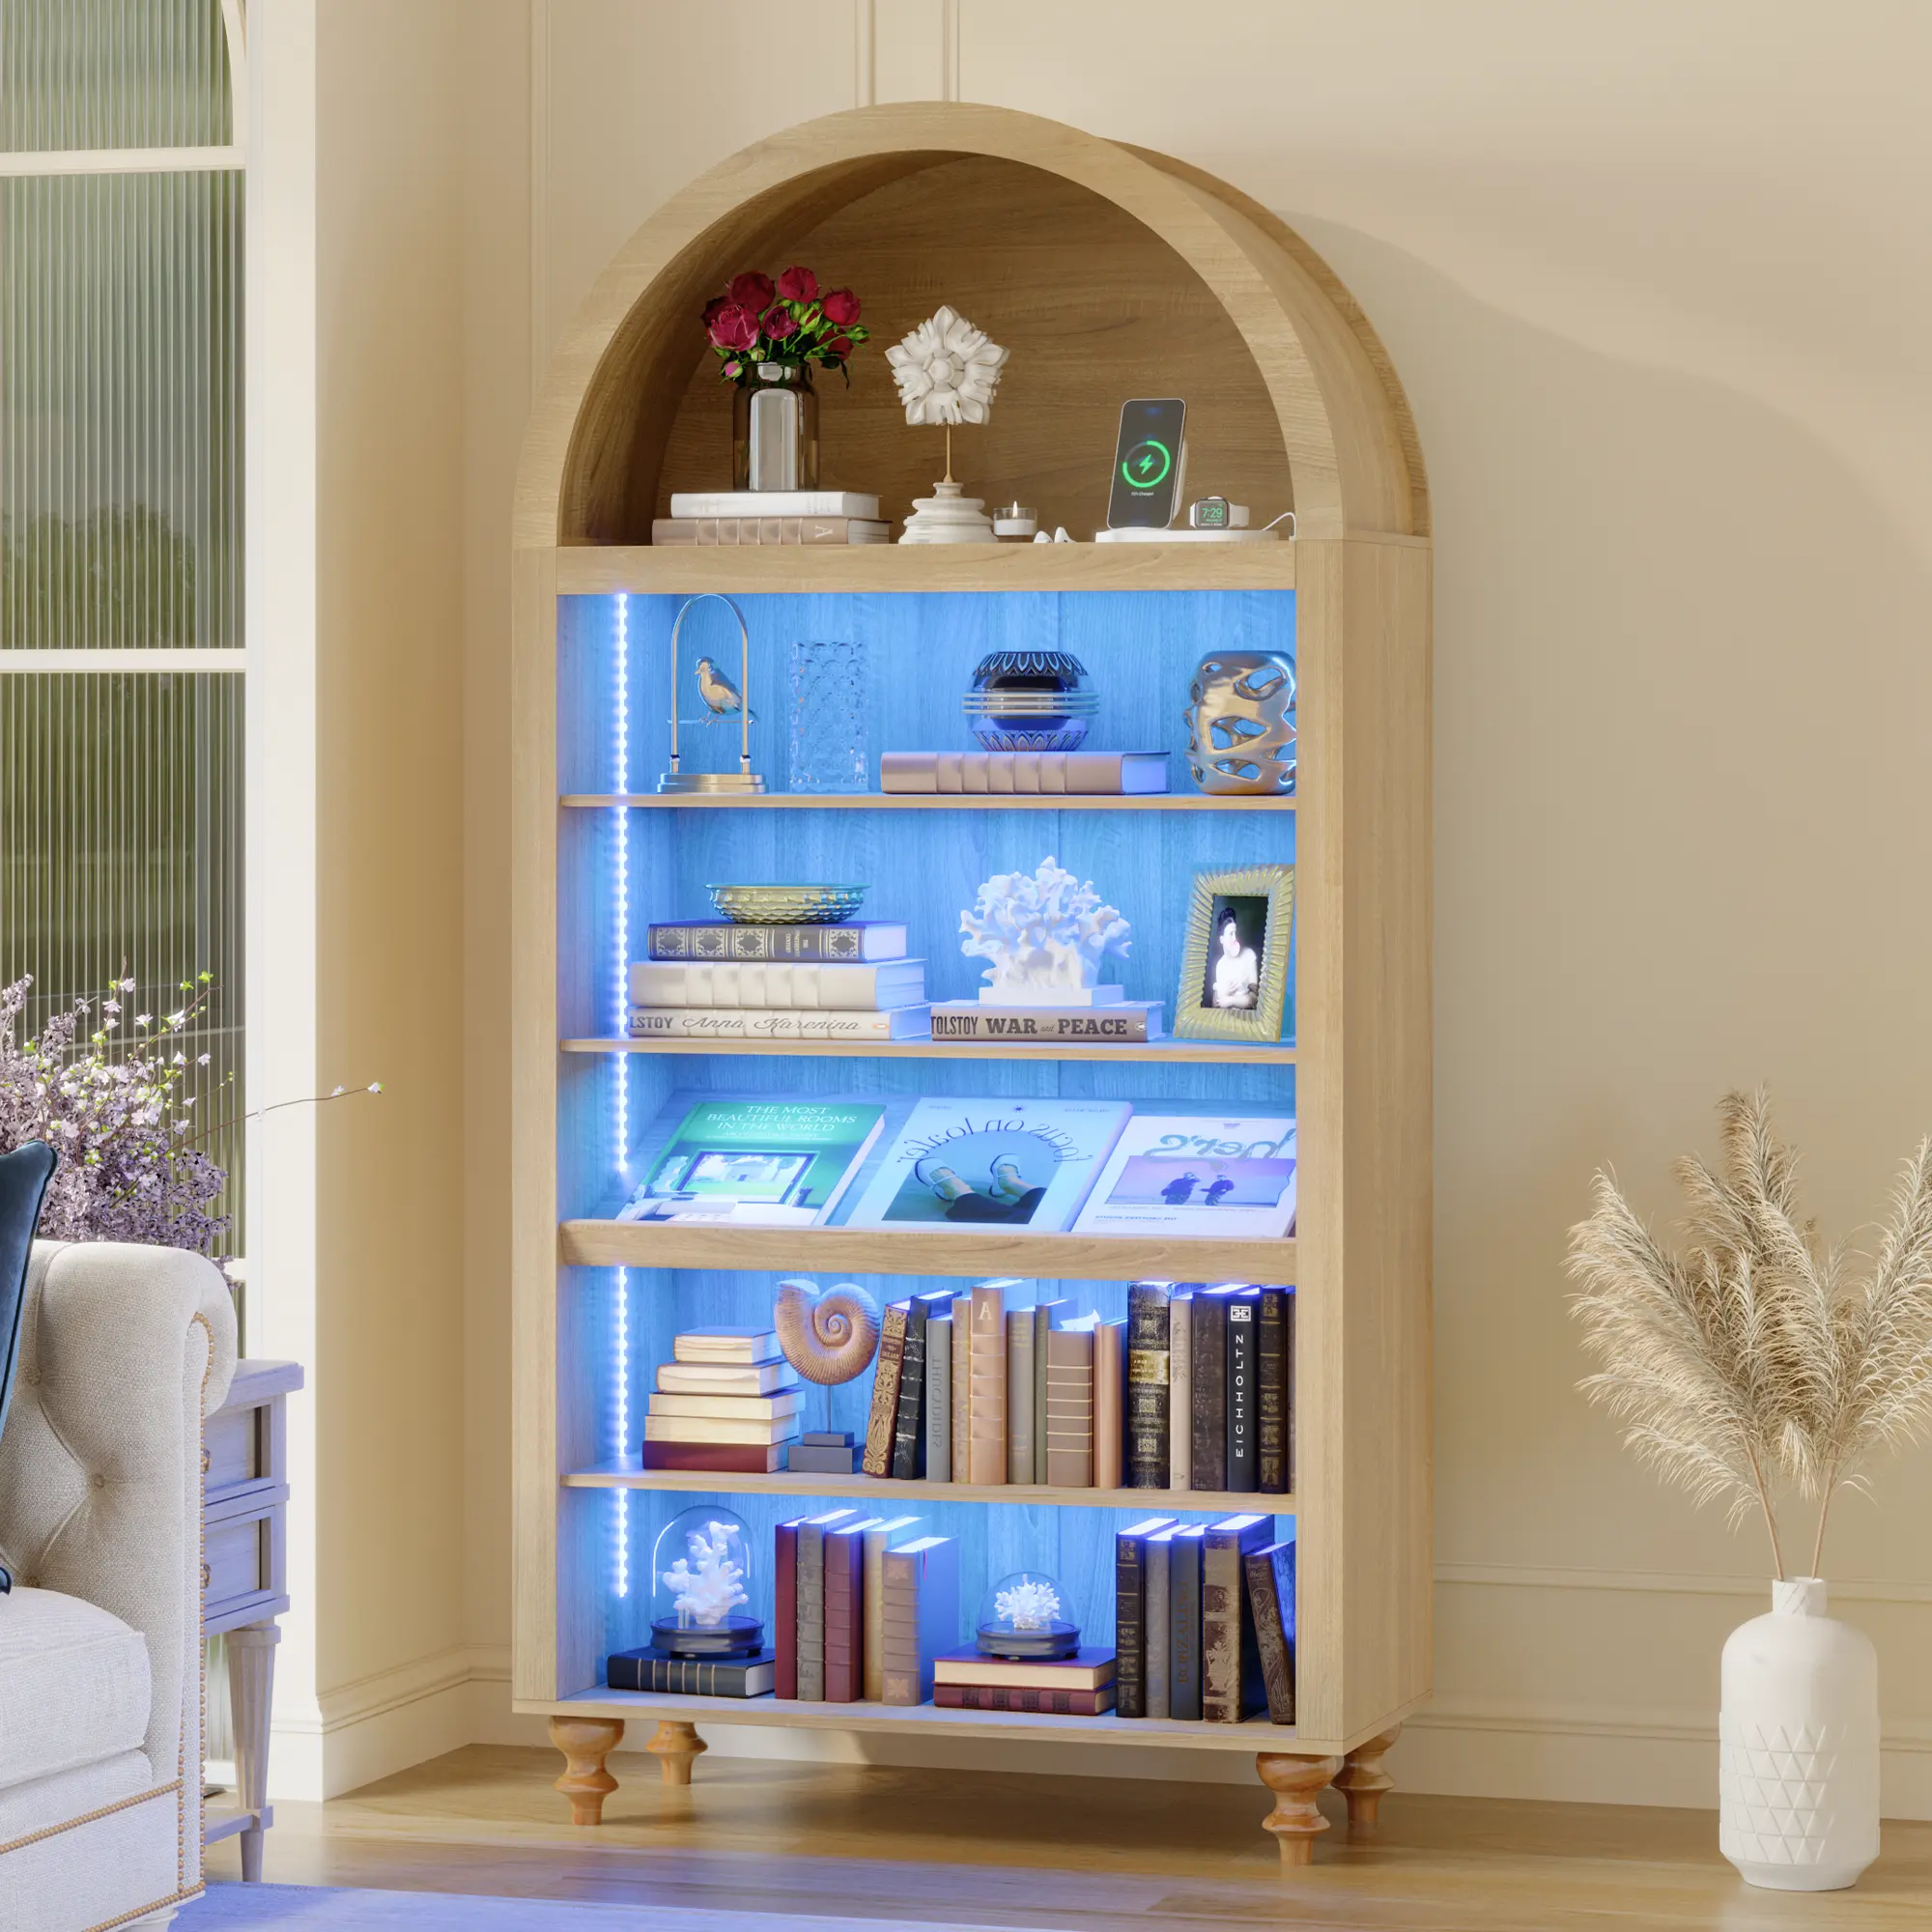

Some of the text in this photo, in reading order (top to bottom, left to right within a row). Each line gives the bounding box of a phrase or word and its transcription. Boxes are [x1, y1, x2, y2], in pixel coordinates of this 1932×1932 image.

[1202, 507, 1223, 518] 7:29
[629, 1016, 862, 1034] LSTOY Anna Karenina
[930, 1016, 1127, 1036] TOLSTOY WAR and PEACE
[746, 1105, 830, 1115] THE MOST
[706, 1114, 858, 1123] BEAUTIFUL ROOMS
[740, 1122, 771, 1131] THE
[776, 1123, 836, 1132] WORLD
[978, 1301, 993, 1321] A
[1236, 1334, 1244, 1458] EICHHOLTZ
